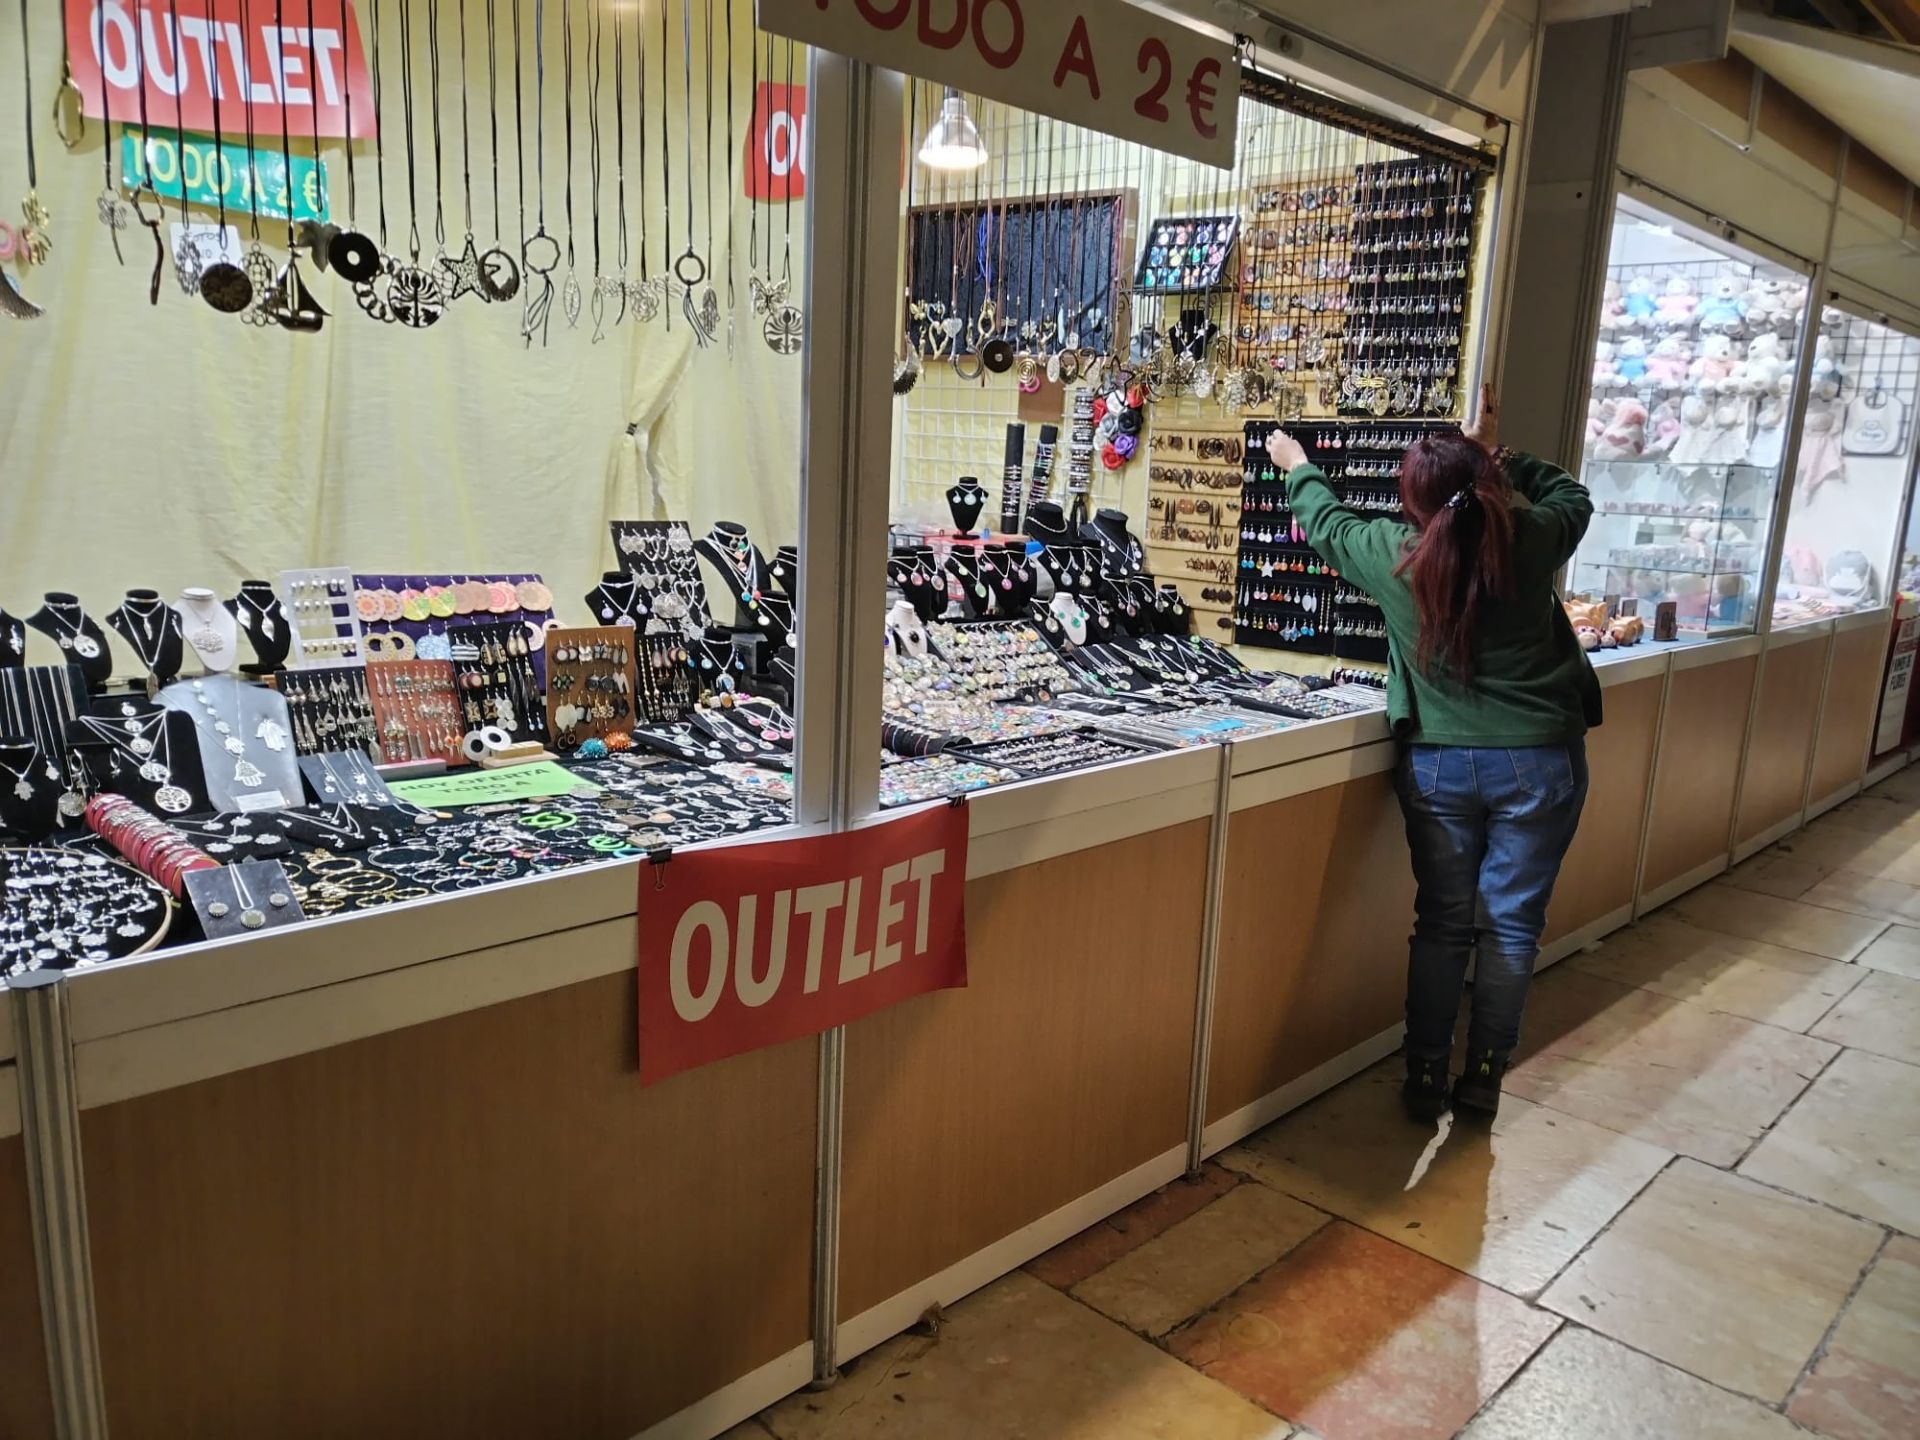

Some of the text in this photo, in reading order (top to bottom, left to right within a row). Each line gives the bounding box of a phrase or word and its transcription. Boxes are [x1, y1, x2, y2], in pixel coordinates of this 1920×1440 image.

[90, 3, 342, 106] OUTLET
[1053, 15, 1101, 100] A
[127, 130, 232, 195] TODO
[400, 768, 551, 791] HOY OFERTA
[437, 783, 507, 793] TODO
[670, 848, 946, 1022] OUTLET
